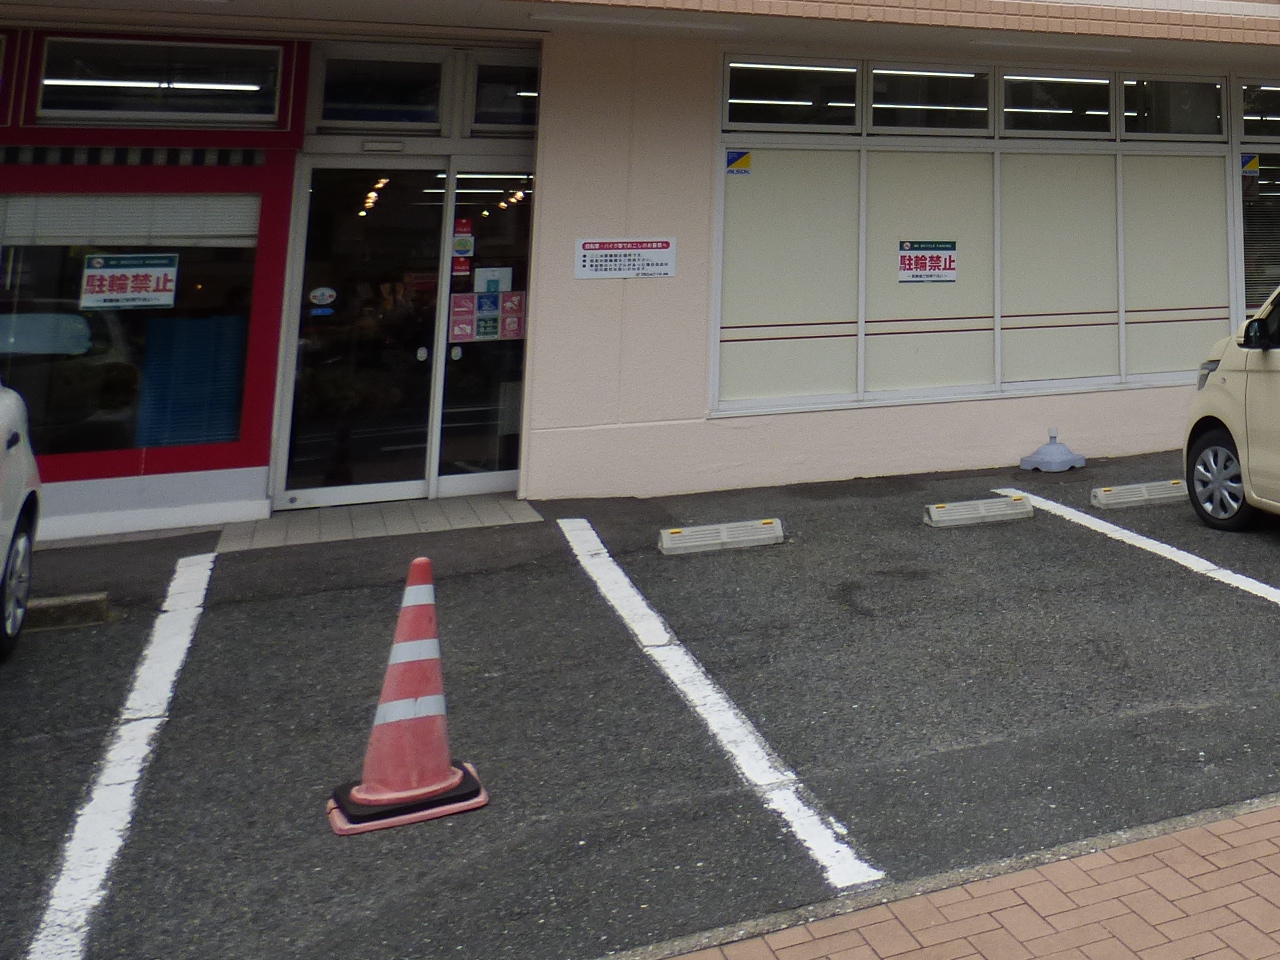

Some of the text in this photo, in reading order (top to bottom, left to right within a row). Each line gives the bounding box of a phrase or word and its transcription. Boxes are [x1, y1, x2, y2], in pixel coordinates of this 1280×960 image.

[899, 254, 956, 271] 駐輪禁止
[84, 272, 174, 295] 駐輪禁止
